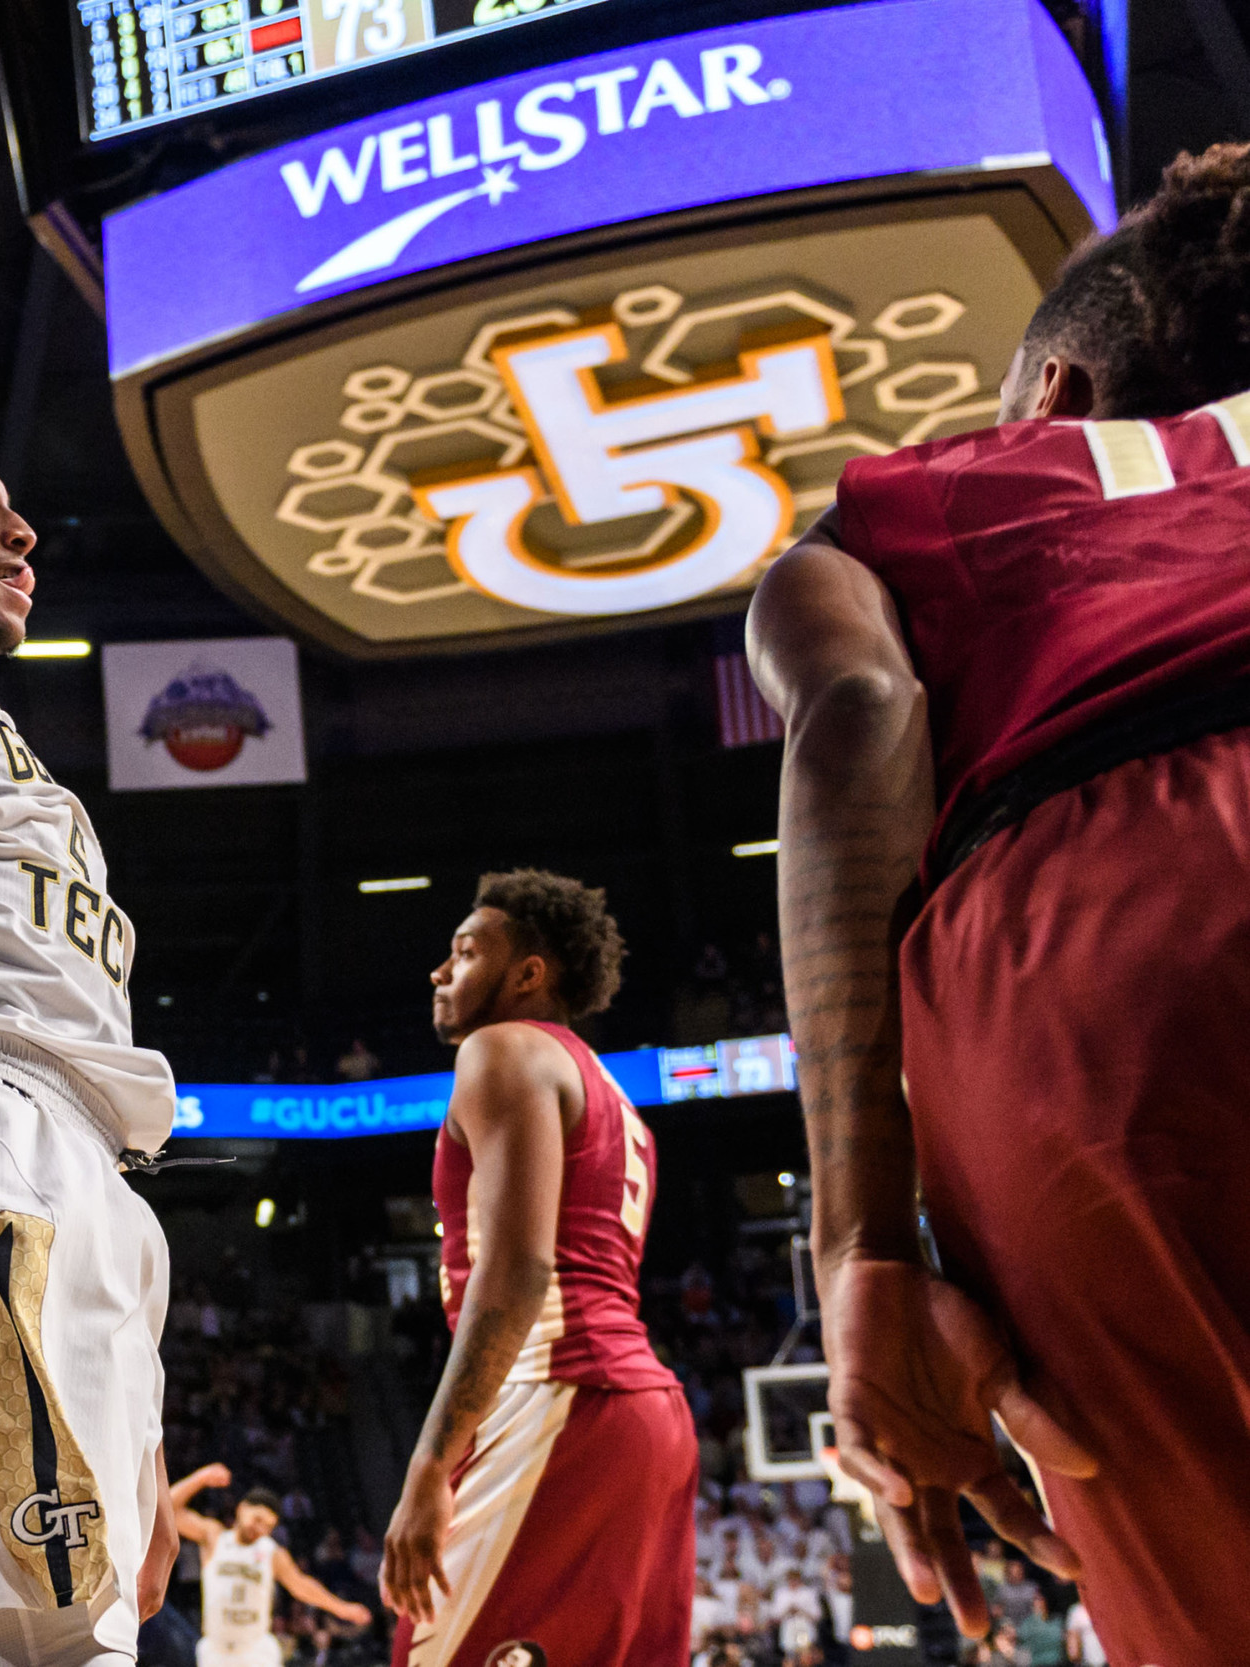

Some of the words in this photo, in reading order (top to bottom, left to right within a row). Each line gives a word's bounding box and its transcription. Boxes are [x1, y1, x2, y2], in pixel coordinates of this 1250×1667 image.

[322, 0, 408, 65] 73
[279, 43, 770, 218] WELLSTAR
[18, 859, 129, 998] TEC
